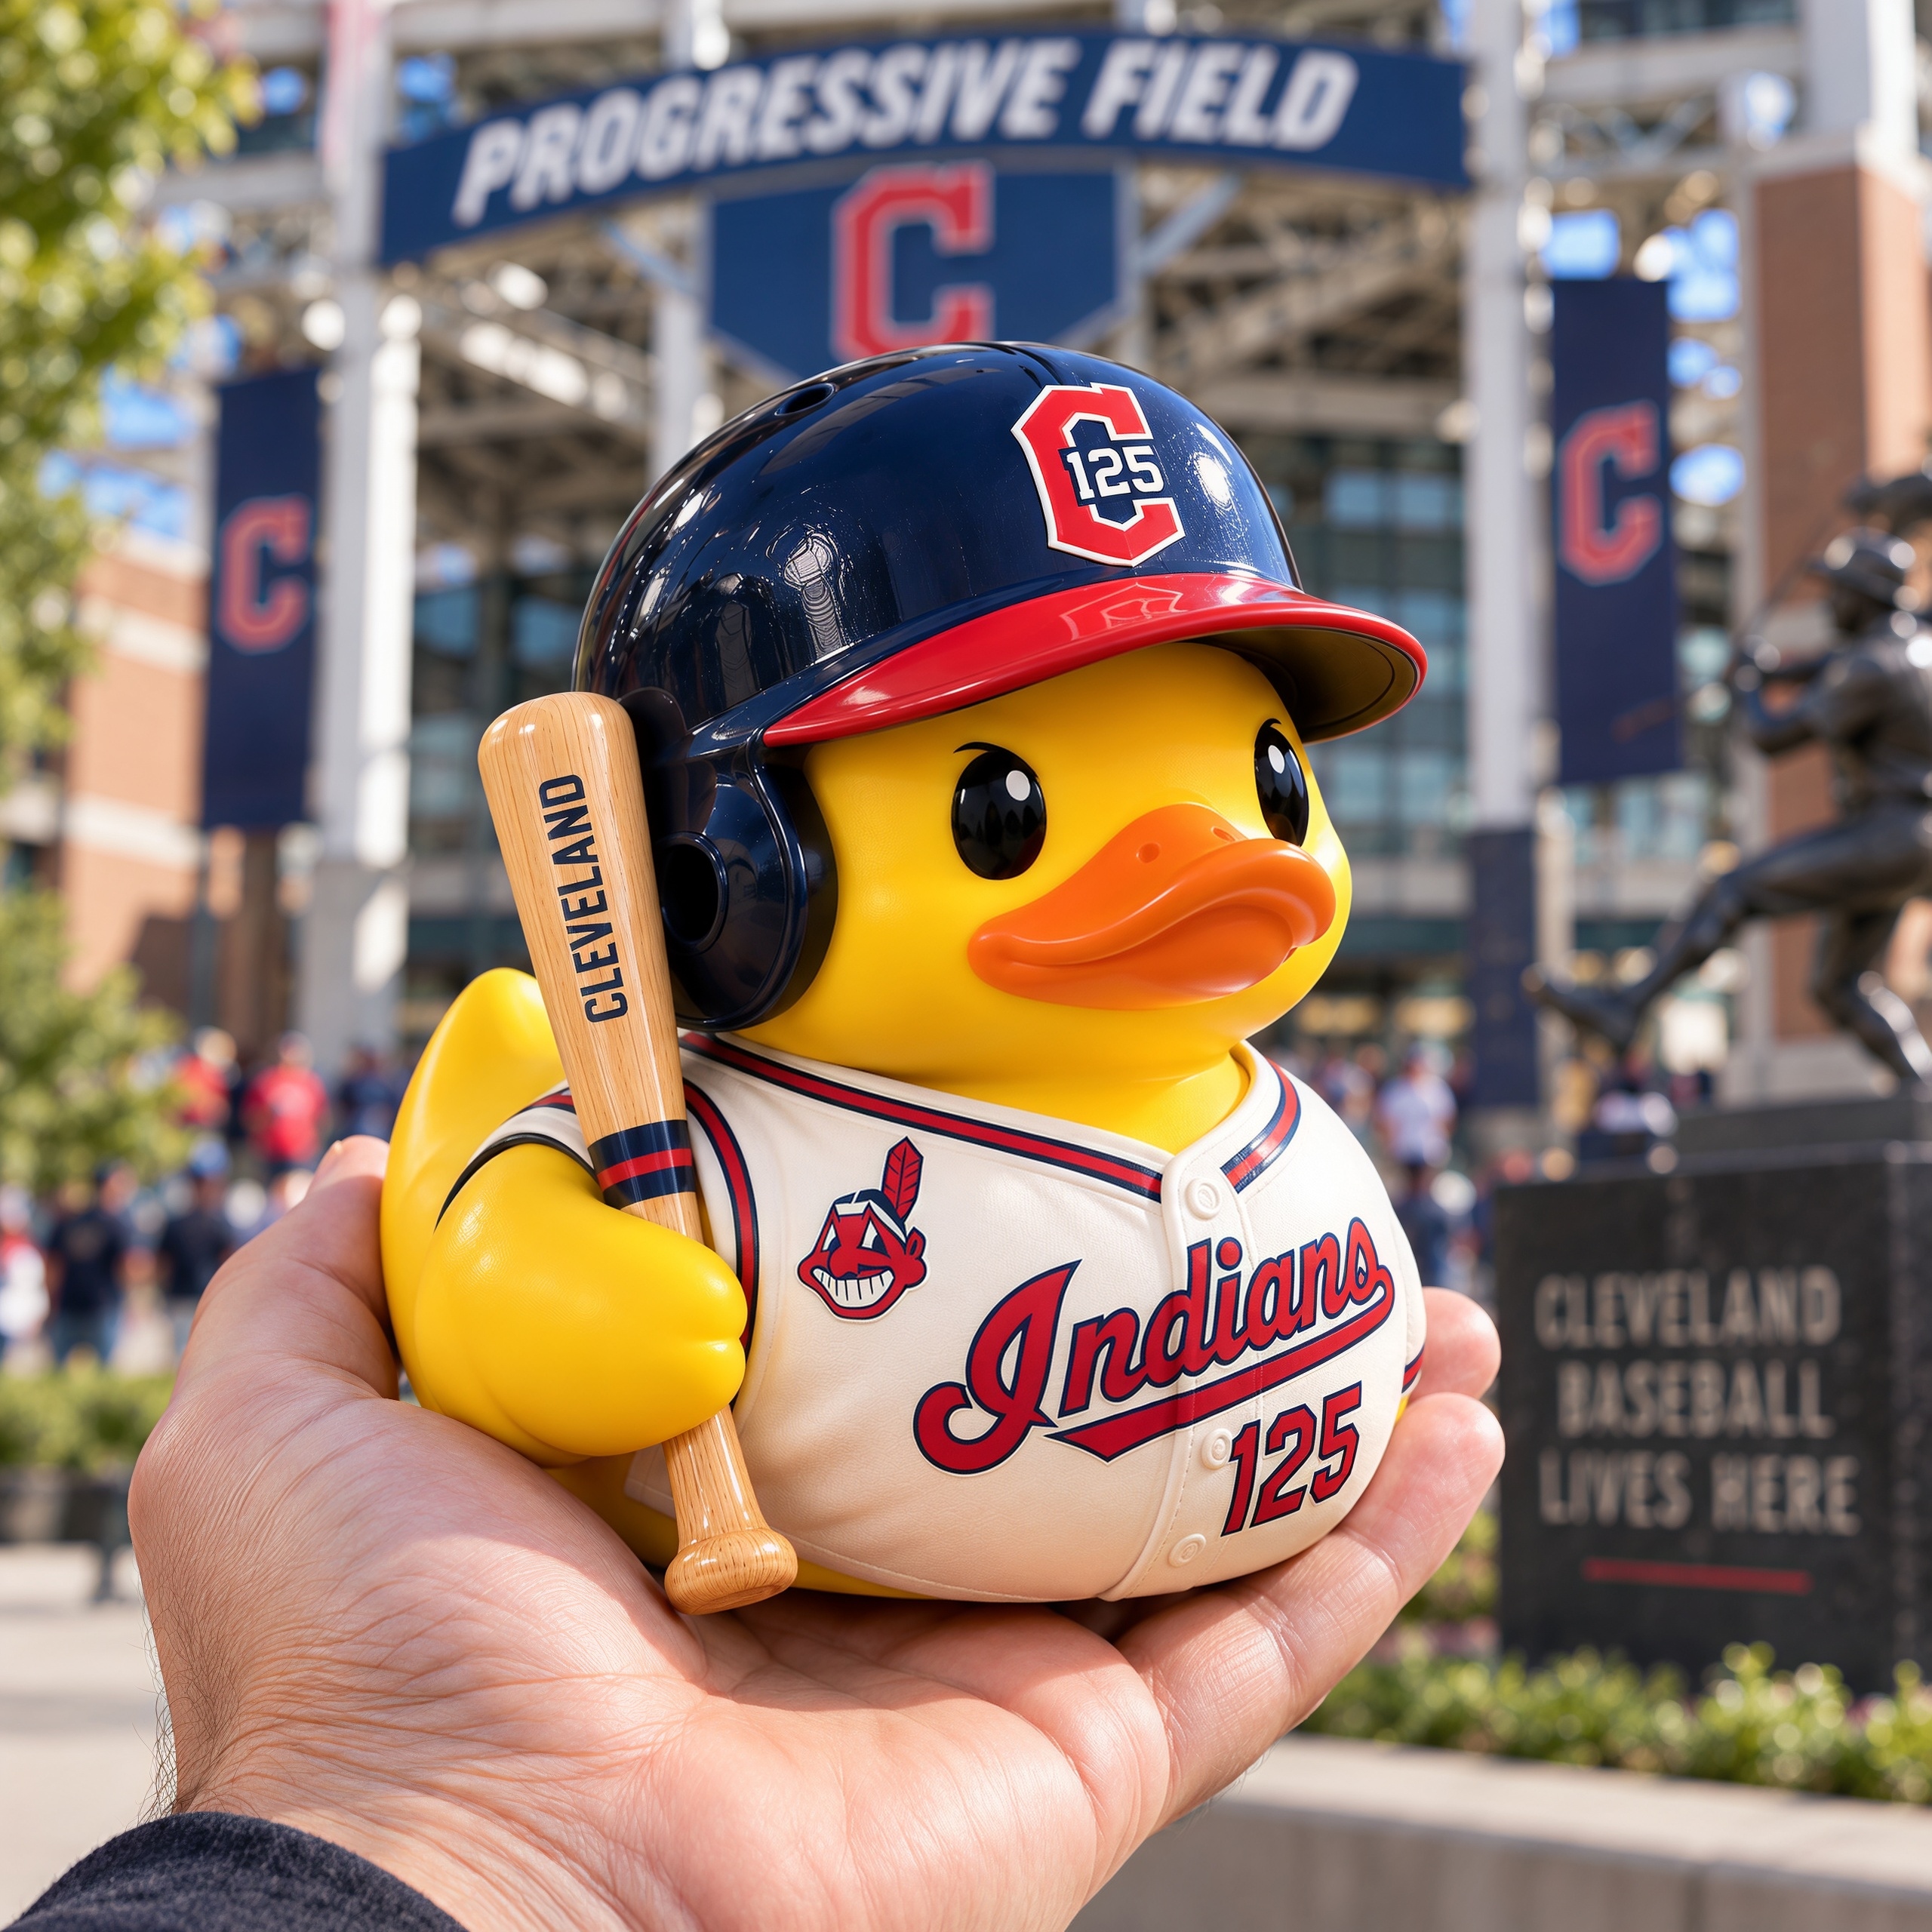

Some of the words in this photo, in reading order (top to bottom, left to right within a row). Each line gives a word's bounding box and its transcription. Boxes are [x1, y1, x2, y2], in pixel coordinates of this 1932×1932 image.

[452, 39, 1078, 226] PROGRESSIVE
[1082, 41, 1358, 150] FIELD
[833, 163, 993, 361] C
[1011, 382, 1186, 568] C
[1066, 445, 1164, 500] 125
[1559, 405, 1658, 583] C
[220, 498, 308, 649] C
[538, 774, 629, 1023] CLEVELAND
[914, 1217, 1395, 1475] Indians
[1536, 1266, 1840, 1348] CLEVELAND
[1220, 1380, 1362, 1538] 125
[1558, 1360, 1835, 1438] BASEBALL
[1538, 1448, 1691, 1529] LIVES
[1711, 1454, 1861, 1537] HERE
